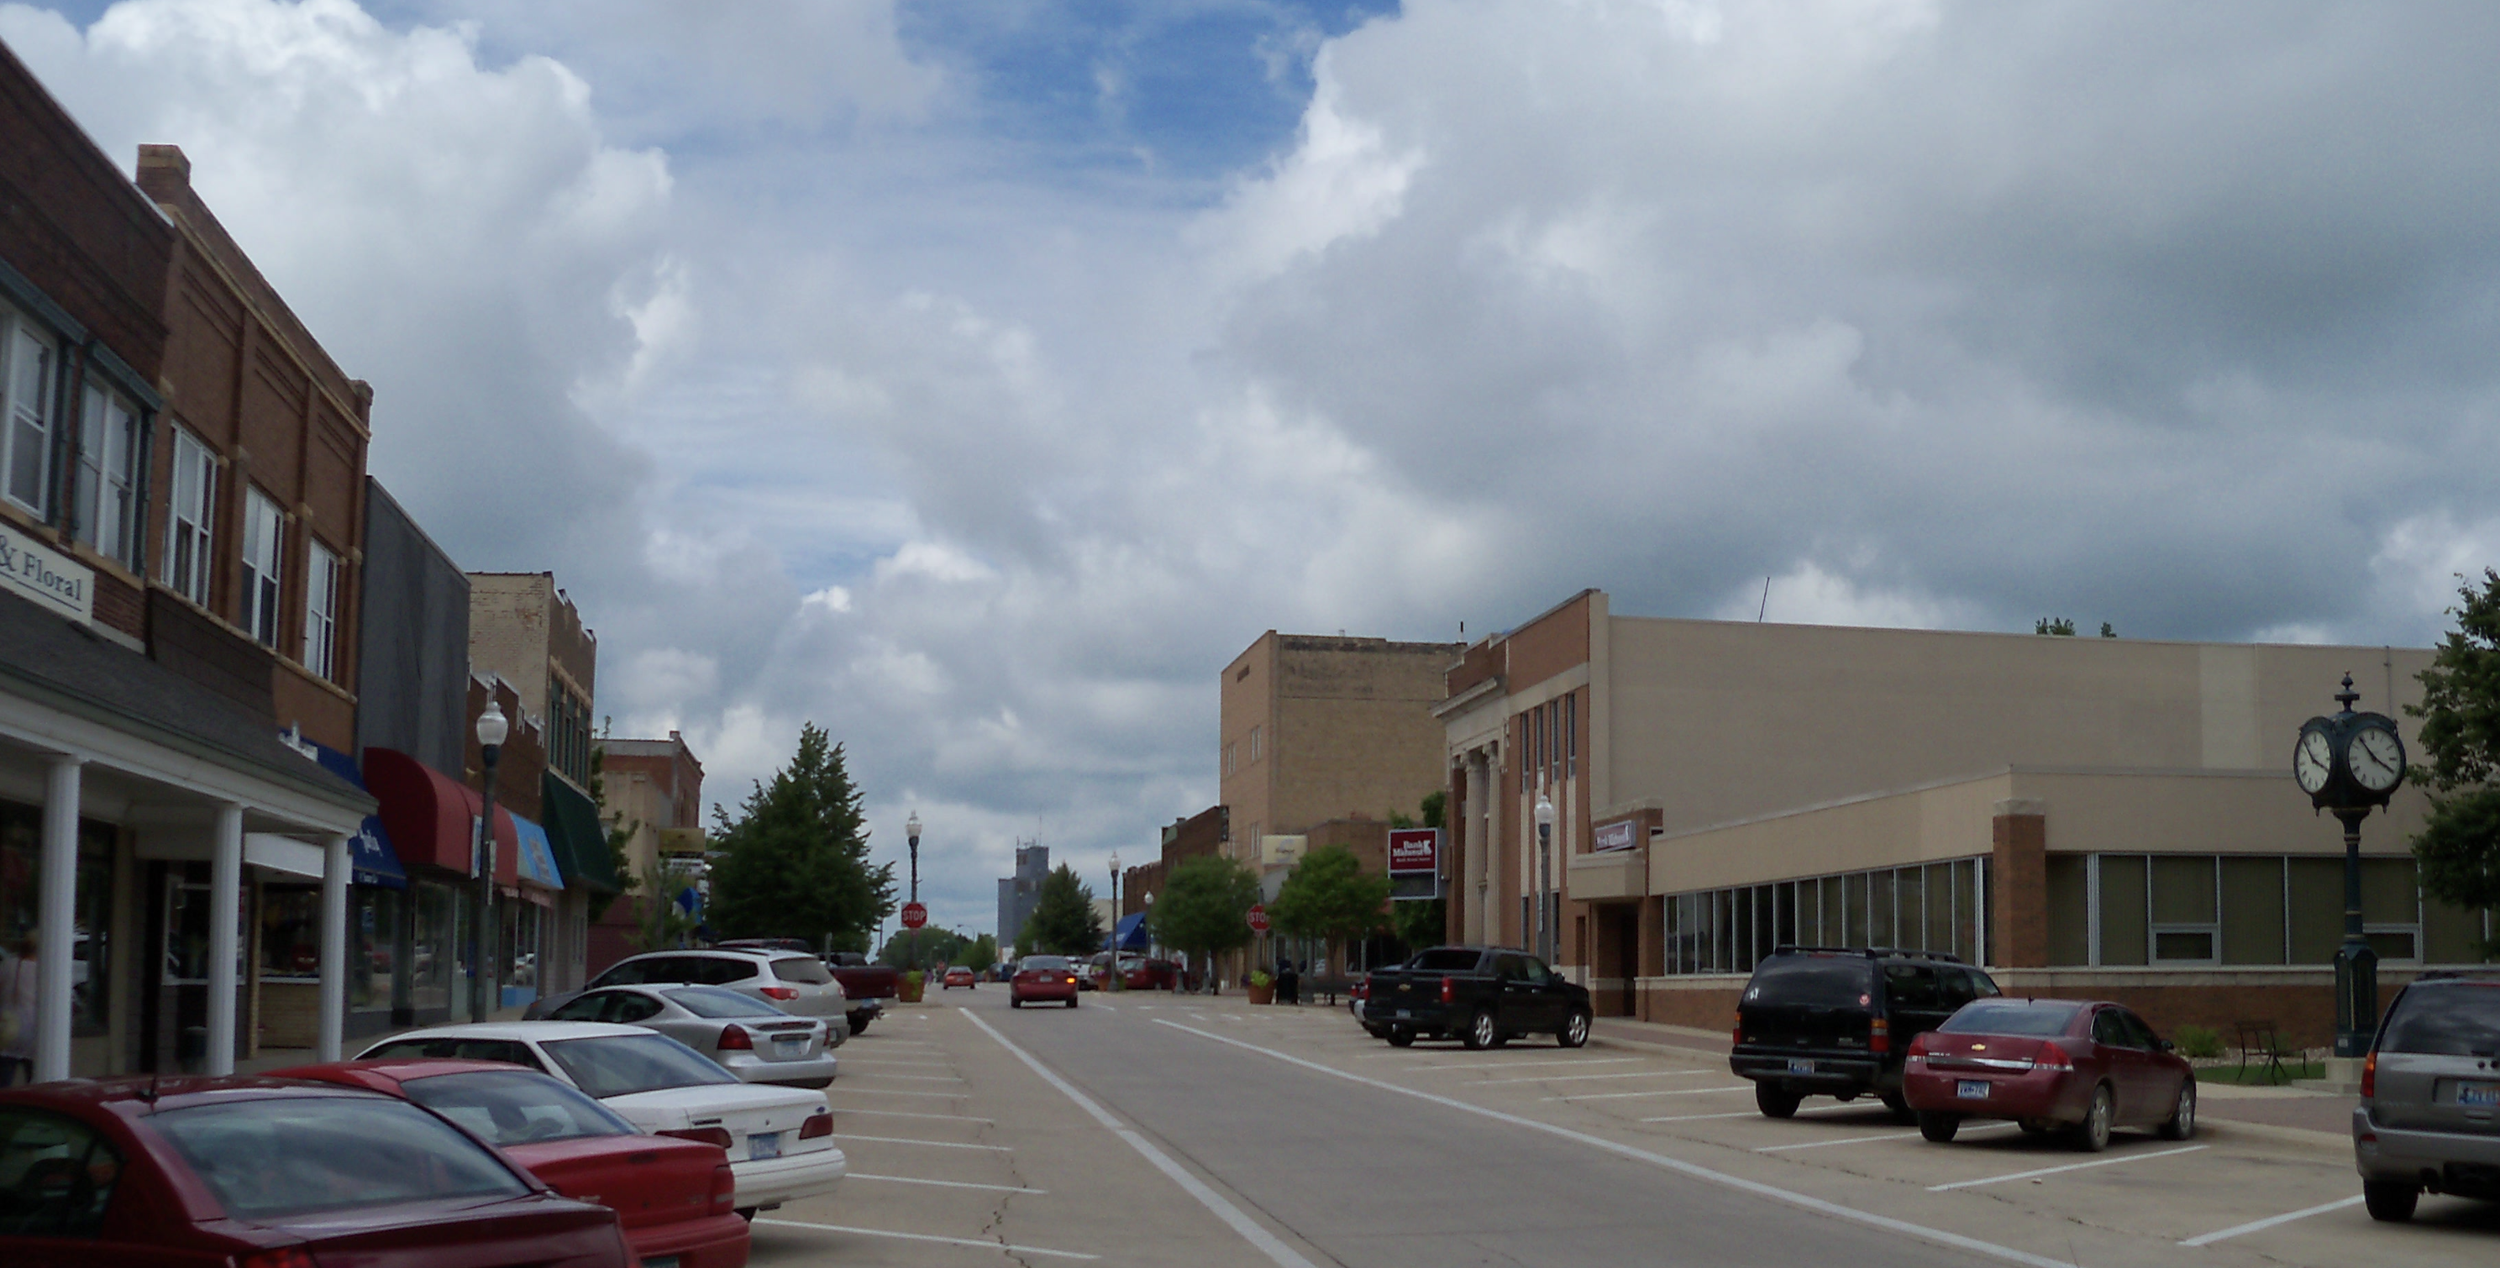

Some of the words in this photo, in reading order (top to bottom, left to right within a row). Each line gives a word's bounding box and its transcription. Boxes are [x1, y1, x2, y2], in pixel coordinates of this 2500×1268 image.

[22, 551, 81, 601] Floral
[1403, 840, 1423, 849] Bank
[902, 910, 926, 921] STOP
